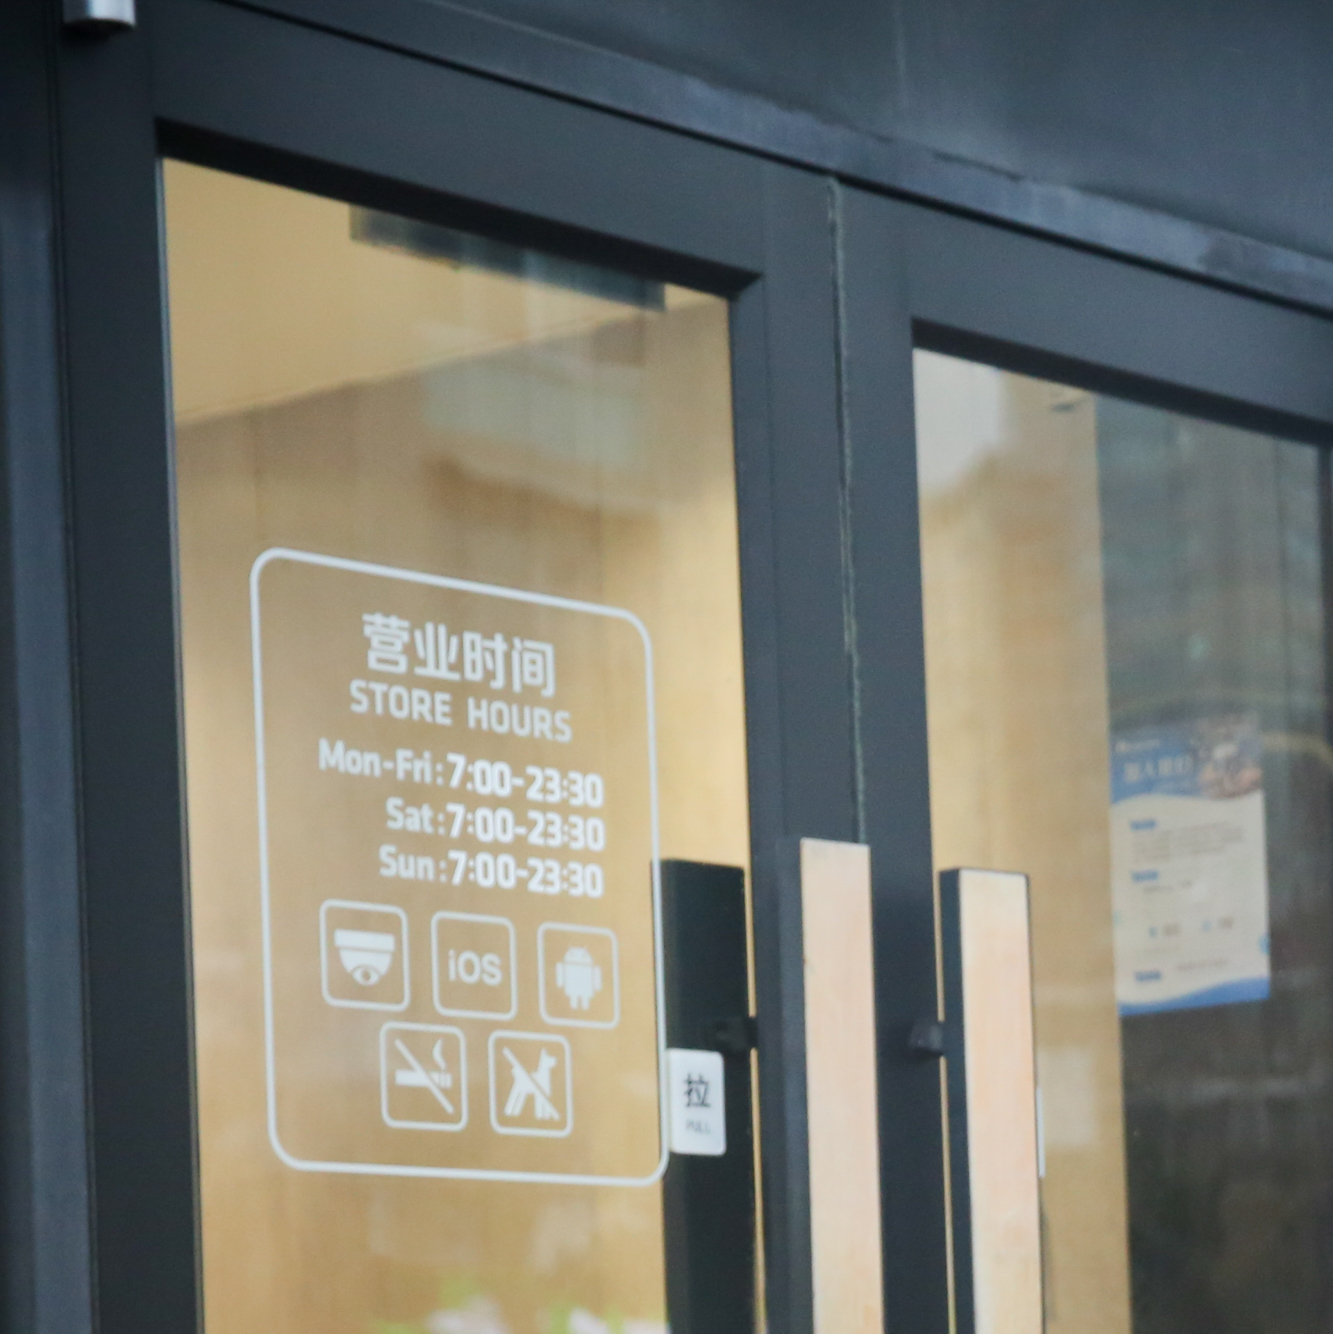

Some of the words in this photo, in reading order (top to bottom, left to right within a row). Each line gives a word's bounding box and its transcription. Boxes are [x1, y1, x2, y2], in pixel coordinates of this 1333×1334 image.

[361, 611, 557, 698] 营业时间
[349, 678, 453, 727] STORE
[466, 696, 573, 744] HOURS
[448, 949, 502, 986] iOS
[683, 1072, 712, 1108] 拉
